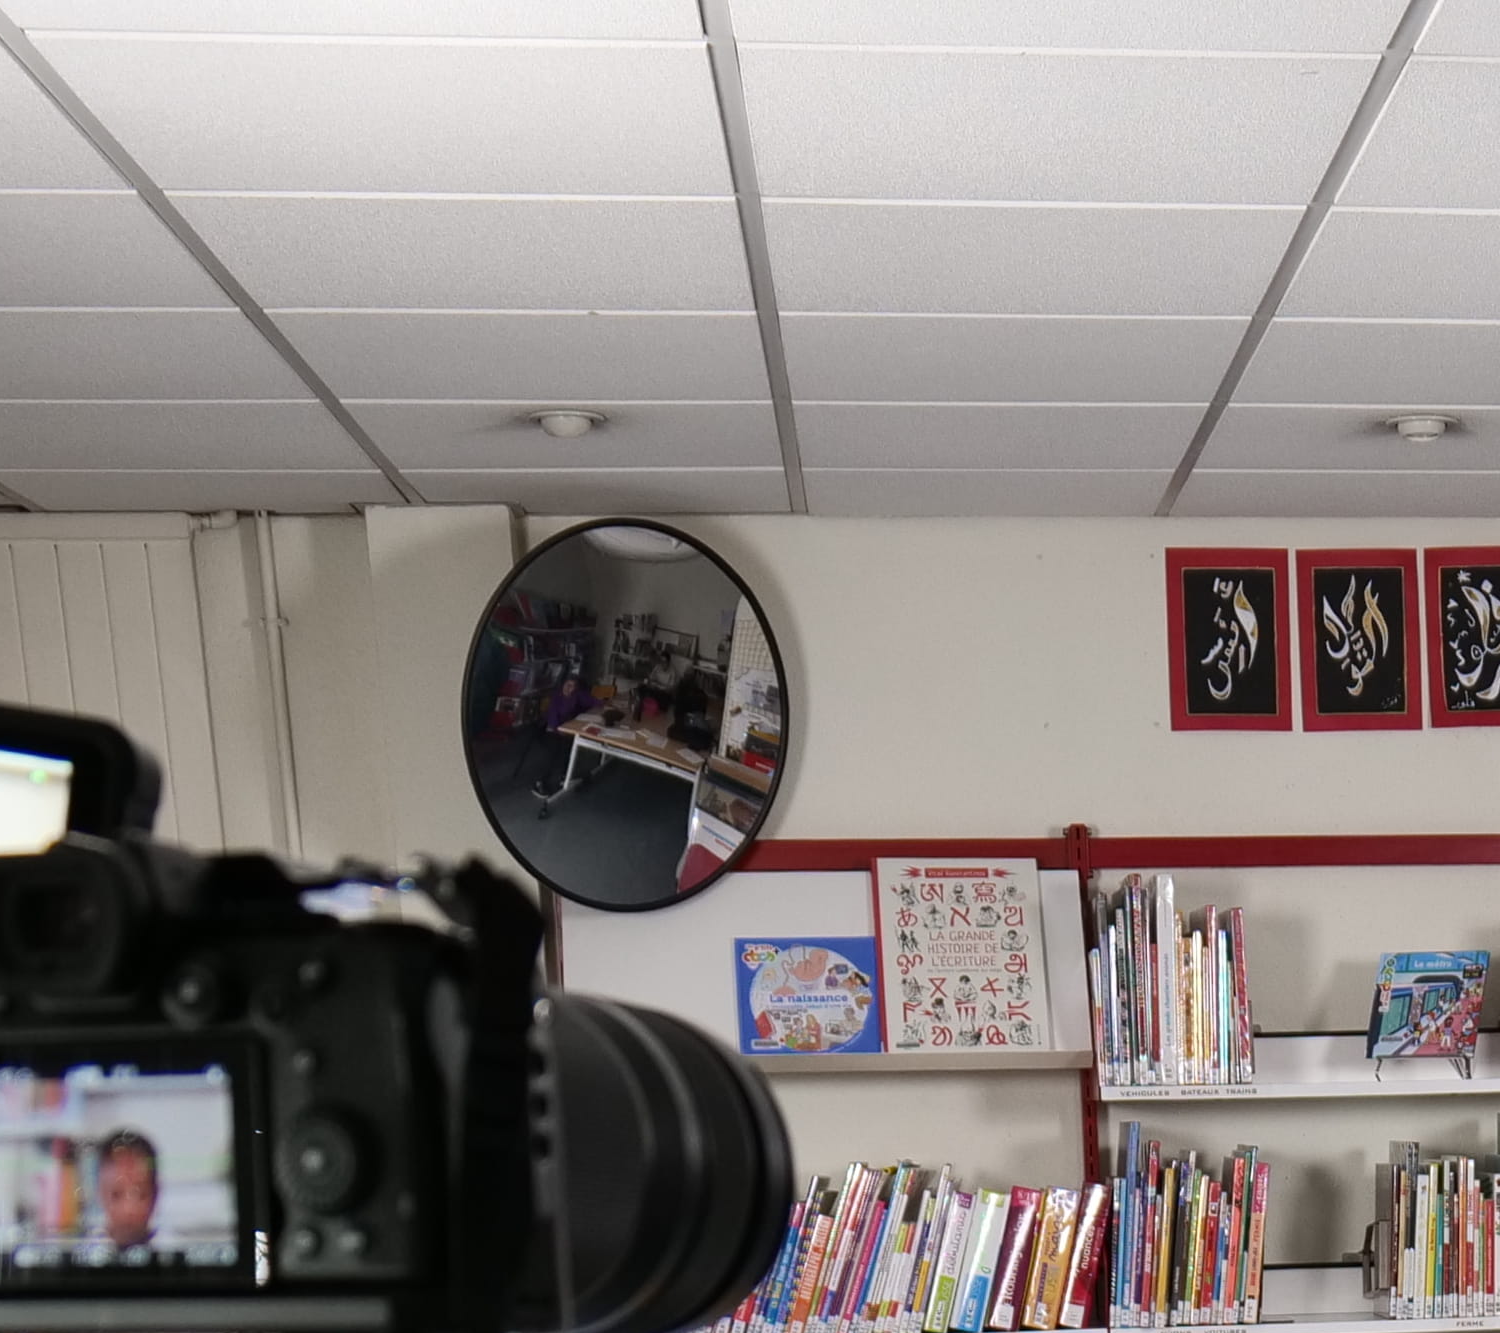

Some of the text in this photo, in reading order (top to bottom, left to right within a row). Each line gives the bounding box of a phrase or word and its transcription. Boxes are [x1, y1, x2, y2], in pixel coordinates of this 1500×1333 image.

[928, 930, 996, 941] LA GRANDE
[927, 943, 998, 955] HISTOIRE DE
[769, 993, 849, 1003] La naissance
[1119, 1086, 1258, 1098] VEHICULES BATEAUX TRAINS
[1080, 1224, 1096, 1270] nuances
[1456, 1320, 1484, 1328] FERME
